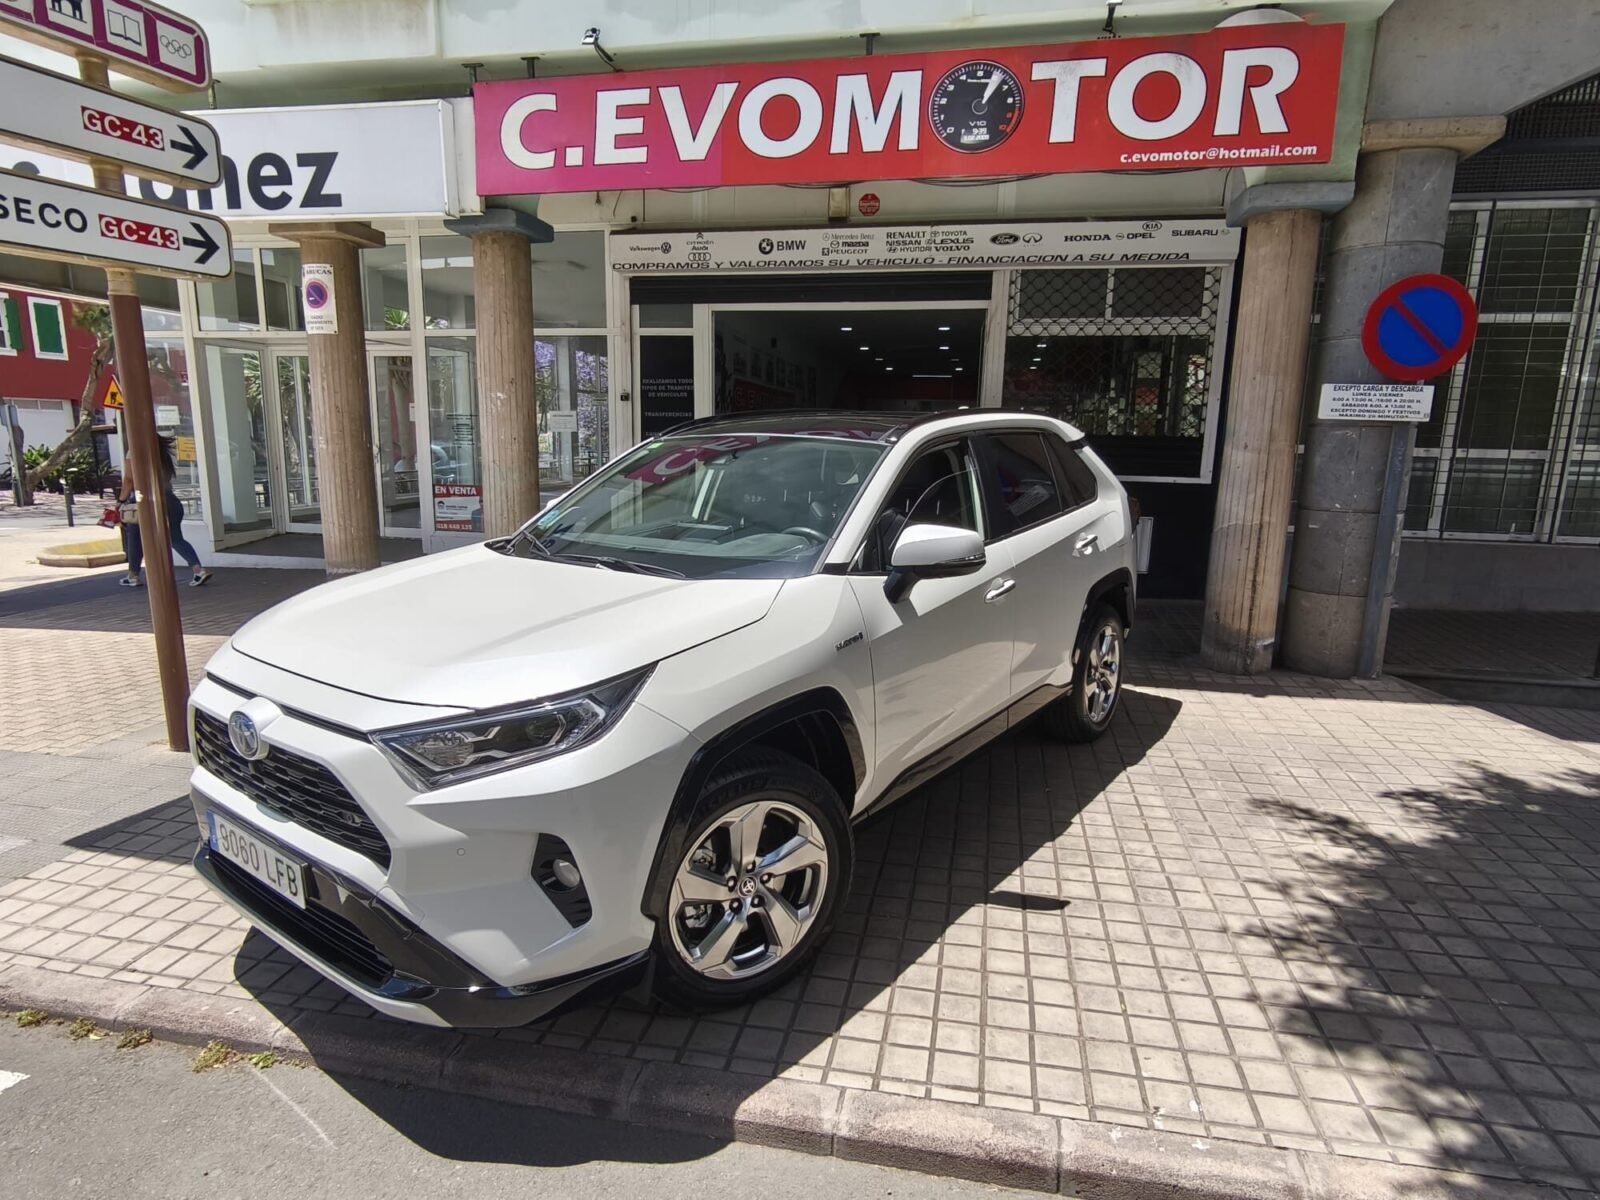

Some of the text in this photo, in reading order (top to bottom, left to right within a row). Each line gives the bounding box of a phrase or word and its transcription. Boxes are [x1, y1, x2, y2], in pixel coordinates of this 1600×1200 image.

[82, 109, 164, 149] GC-43
[1119, 144, 1318, 164] c.evomotor@hotmail.com
[100, 216, 180, 250] GC-43
[886, 231, 927, 239] RENAULT
[1126, 232, 1156, 240] OPEL
[1171, 229, 1218, 237] SUBARU
[933, 237, 974, 245] LEXUS
[1063, 234, 1112, 242] HONDA
[777, 240, 807, 251] BMW
[885, 239, 922, 247] NISSAN
[612, 262, 710, 270] COMPRAMOS
[714, 261, 725, 269] Y
[729, 259, 824, 268] VALORAMOS
[828, 258, 850, 267] SU
[857, 256, 934, 266] VEHICULO
[946, 254, 1069, 264] FINANCIACION
[1071, 253, 1084, 262] A
[1088, 252, 1115, 262] SU
[1120, 252, 1190, 261] MEDIDA
[1391, 385, 1424, 393] DESCARGA
[435, 486, 477, 495] EN VENTA
[219, 823, 299, 897] 9060 LFB
